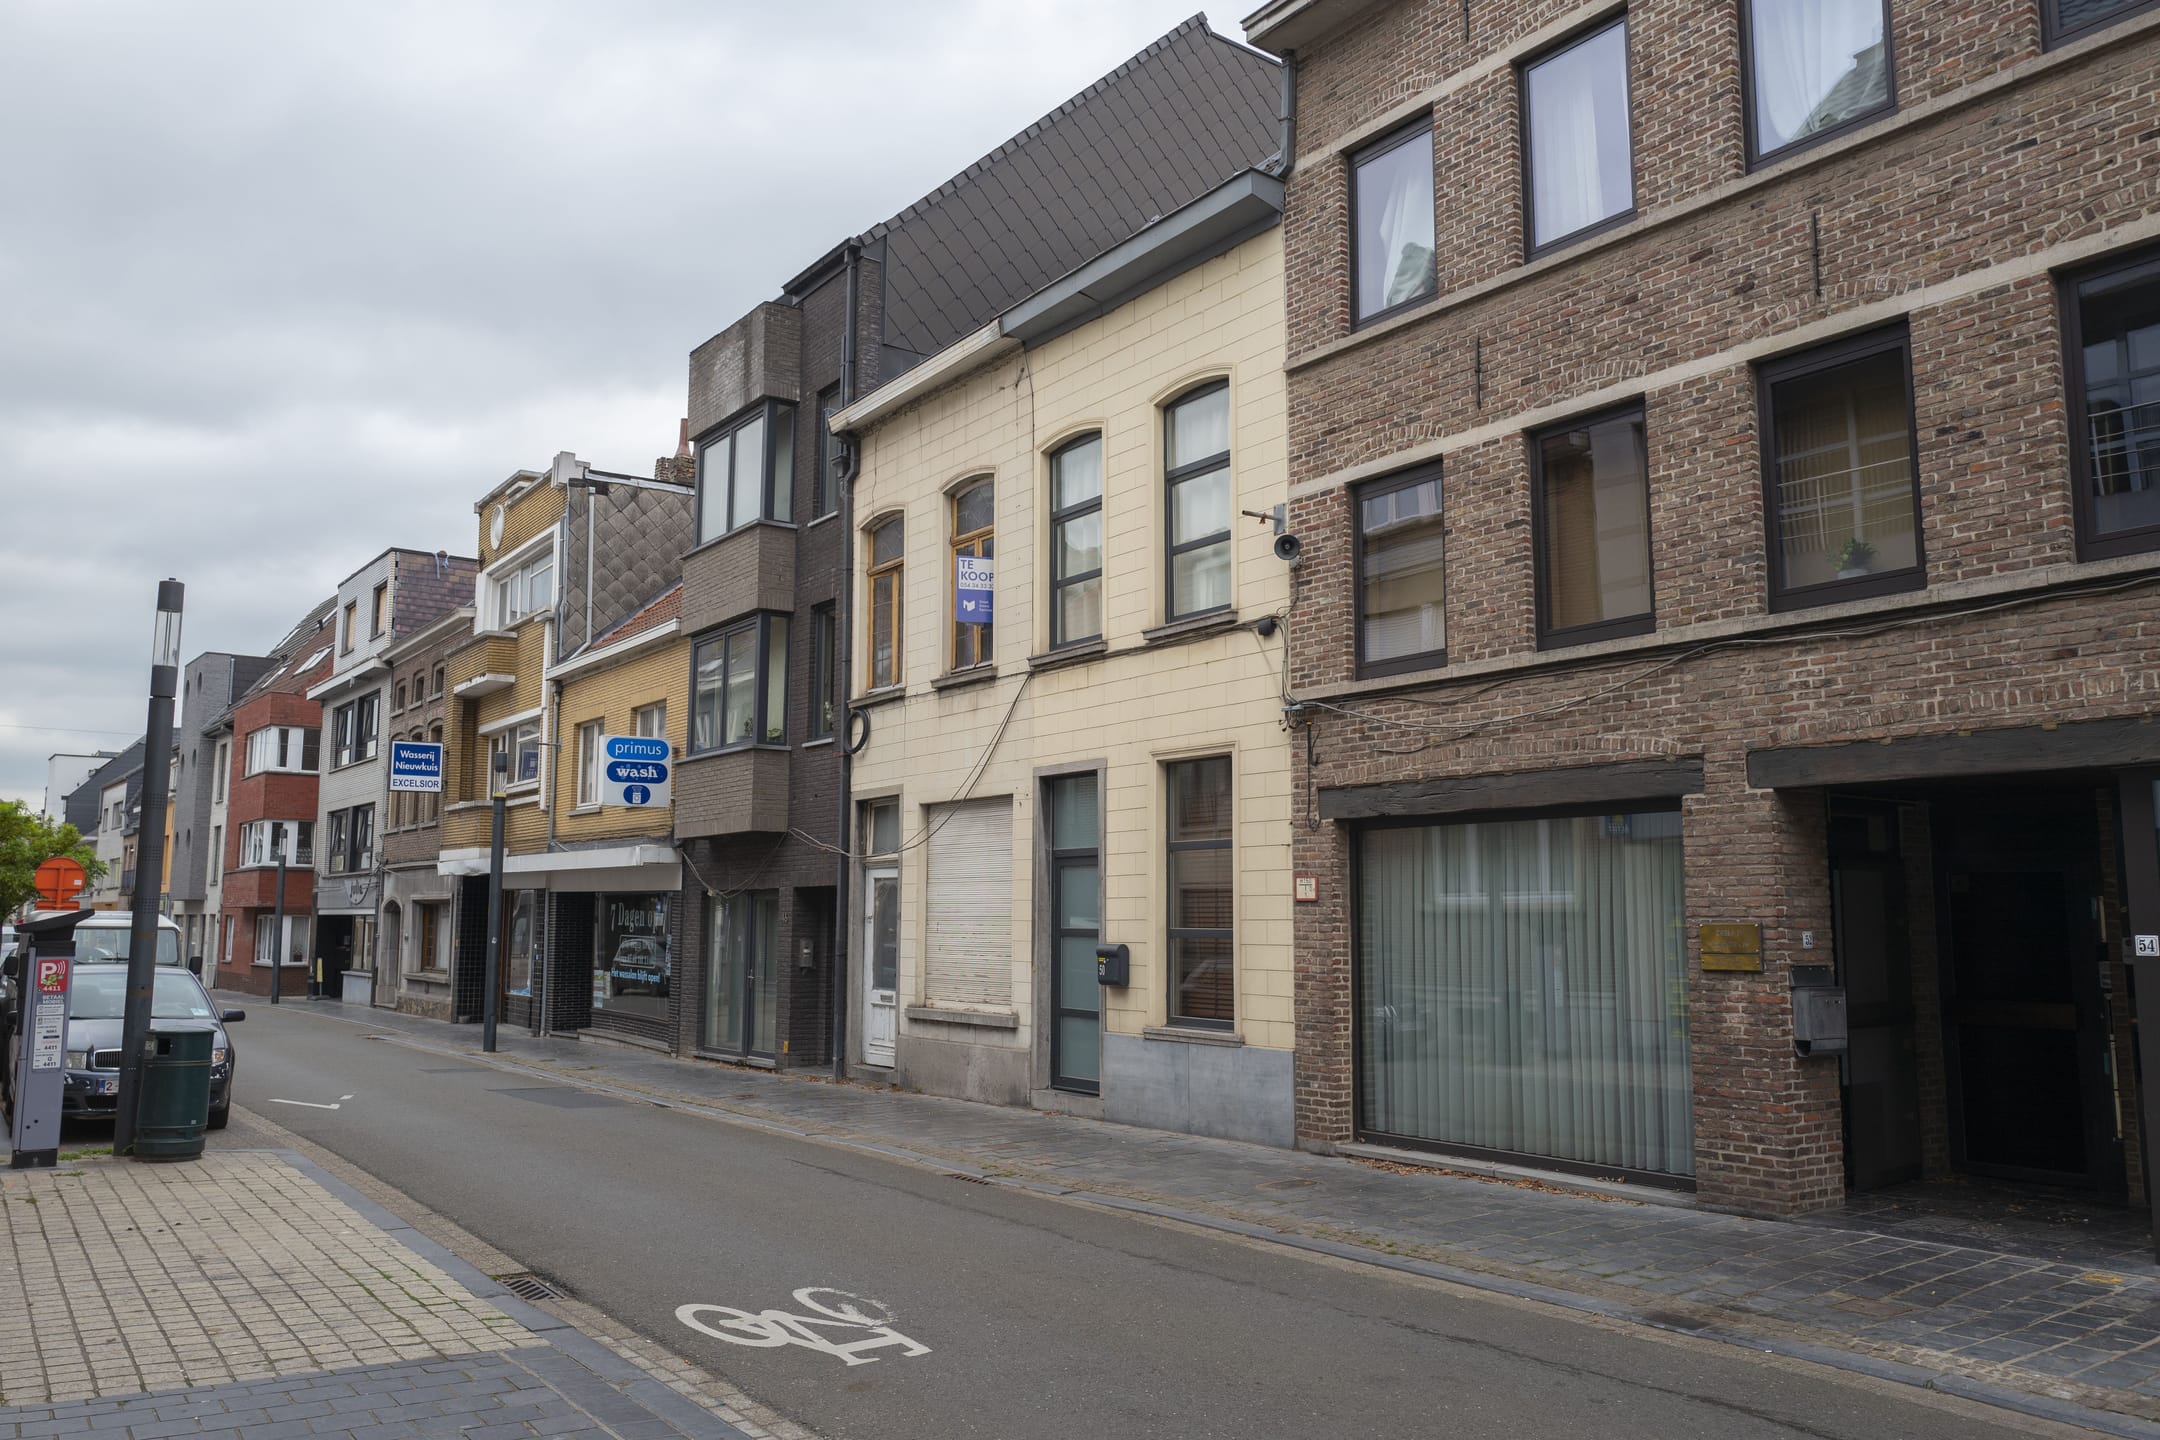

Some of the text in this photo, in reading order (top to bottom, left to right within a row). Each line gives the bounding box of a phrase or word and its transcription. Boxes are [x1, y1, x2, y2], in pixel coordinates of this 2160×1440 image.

[960, 559, 974, 570] TE
[960, 571, 994, 582] KOOP
[400, 749, 435, 762] Wasserij
[615, 741, 662, 757] primus
[395, 760, 439, 772] Nieuwkuis
[615, 764, 658, 778] wash
[392, 778, 440, 788] EXCELSIOR
[610, 903, 616, 932] 7
[617, 902, 645, 933] Dagen
[2138, 938, 2156, 953] 54
[41, 962, 58, 984] P
[1099, 964, 1106, 976] 50
